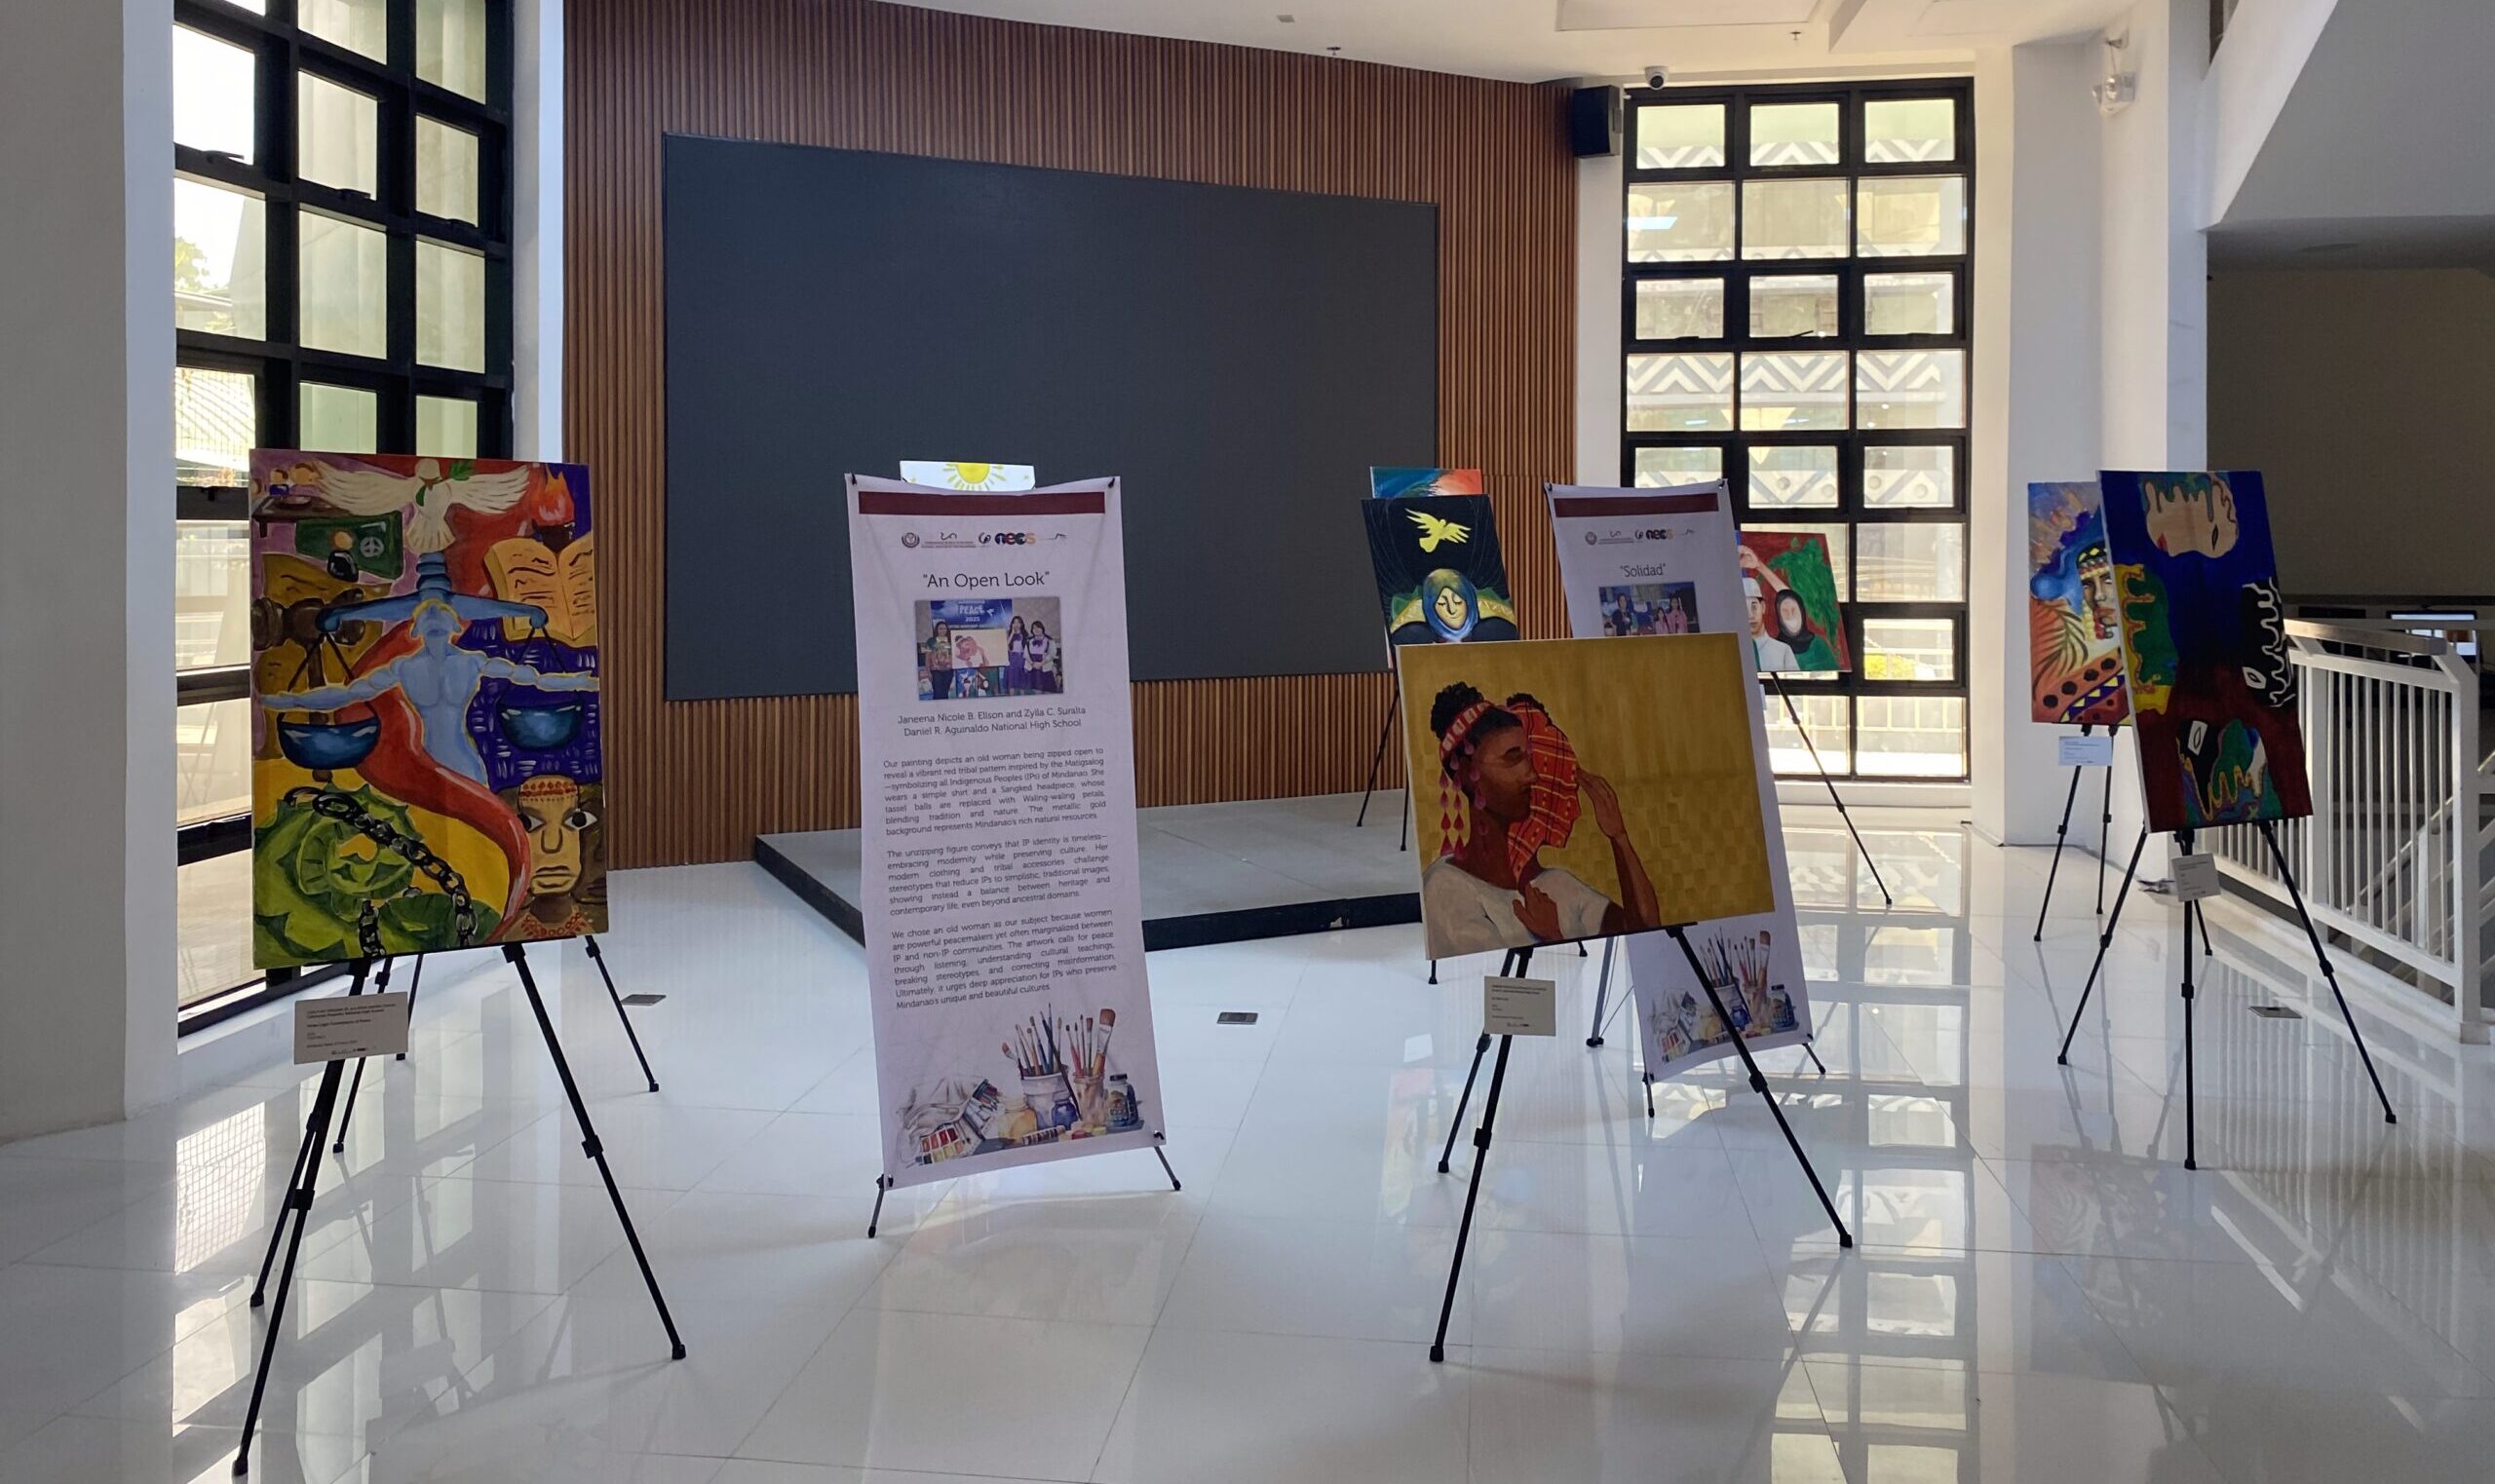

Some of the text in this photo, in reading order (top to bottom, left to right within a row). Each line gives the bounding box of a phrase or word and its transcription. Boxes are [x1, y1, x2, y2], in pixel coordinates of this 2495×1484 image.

[923, 571, 1050, 590] "An Open Look"
[904, 727, 932, 736] Daniel
[944, 724, 989, 735] Aguinaldo
[991, 722, 1027, 731] National
[1030, 720, 1050, 730] High
[1053, 718, 1081, 727] School
[902, 758, 933, 769] painting
[935, 756, 962, 766] depicts
[1047, 748, 1072, 758] zipped
[1074, 748, 1093, 757] open
[916, 768, 941, 777] vibrant
[979, 765, 1007, 775] pattern
[1008, 762, 1038, 772] inspired
[950, 777, 992, 786] Indigenous
[994, 774, 1022, 783] Peoples
[922, 790, 946, 799] simple
[885, 804, 907, 813] tassel
[959, 798, 991, 808] replaced
[929, 812, 961, 820] tradition
[1052, 802, 1081, 811] metallic
[1090, 800, 1106, 810] gold
[886, 825, 932, 835] background
[934, 821, 973, 832] represents
[1035, 814, 1060, 822] natural
[905, 847, 943, 856] unzipping
[1032, 836, 1060, 845] identity
[887, 859, 929, 869] embracing
[937, 856, 977, 864] modernity
[1013, 849, 1052, 859] preserving
[929, 868, 960, 877] clothing
[994, 862, 1014, 871] tribal
[1022, 858, 1065, 868] accessories
[1074, 855, 1109, 863] challenge
[889, 883, 933, 893] stereotypes
[1043, 867, 1080, 877] traditional
[889, 894, 923, 903] showing
[931, 891, 959, 899] instead
[890, 904, 944, 915] contemporary
[981, 896, 1011, 906] beyond
[1012, 893, 1046, 902] ancestral
[1021, 915, 1048, 925] subject
[906, 938, 941, 950] powerful
[943, 933, 993, 946] peacemakers
[995, 931, 1007, 940] yet
[1031, 923, 1079, 935] marginalized
[1081, 920, 1112, 929] between
[923, 949, 949, 958] non-IP
[1026, 936, 1055, 946] artwork
[1057, 934, 1074, 943] calls
[1092, 932, 1113, 941] peace
[894, 964, 925, 973] through
[978, 952, 1032, 964] understanding
[1041, 946, 1069, 956] cultural
[895, 975, 928, 985] breaking
[1011, 961, 1050, 970] correcting
[945, 983, 967, 992] urges
[990, 973, 1037, 986] appreciation
[1085, 965, 1116, 975] preserve
[940, 995, 967, 1004] unique
[969, 991, 983, 1000] and
[984, 987, 1017, 997] beautiful
